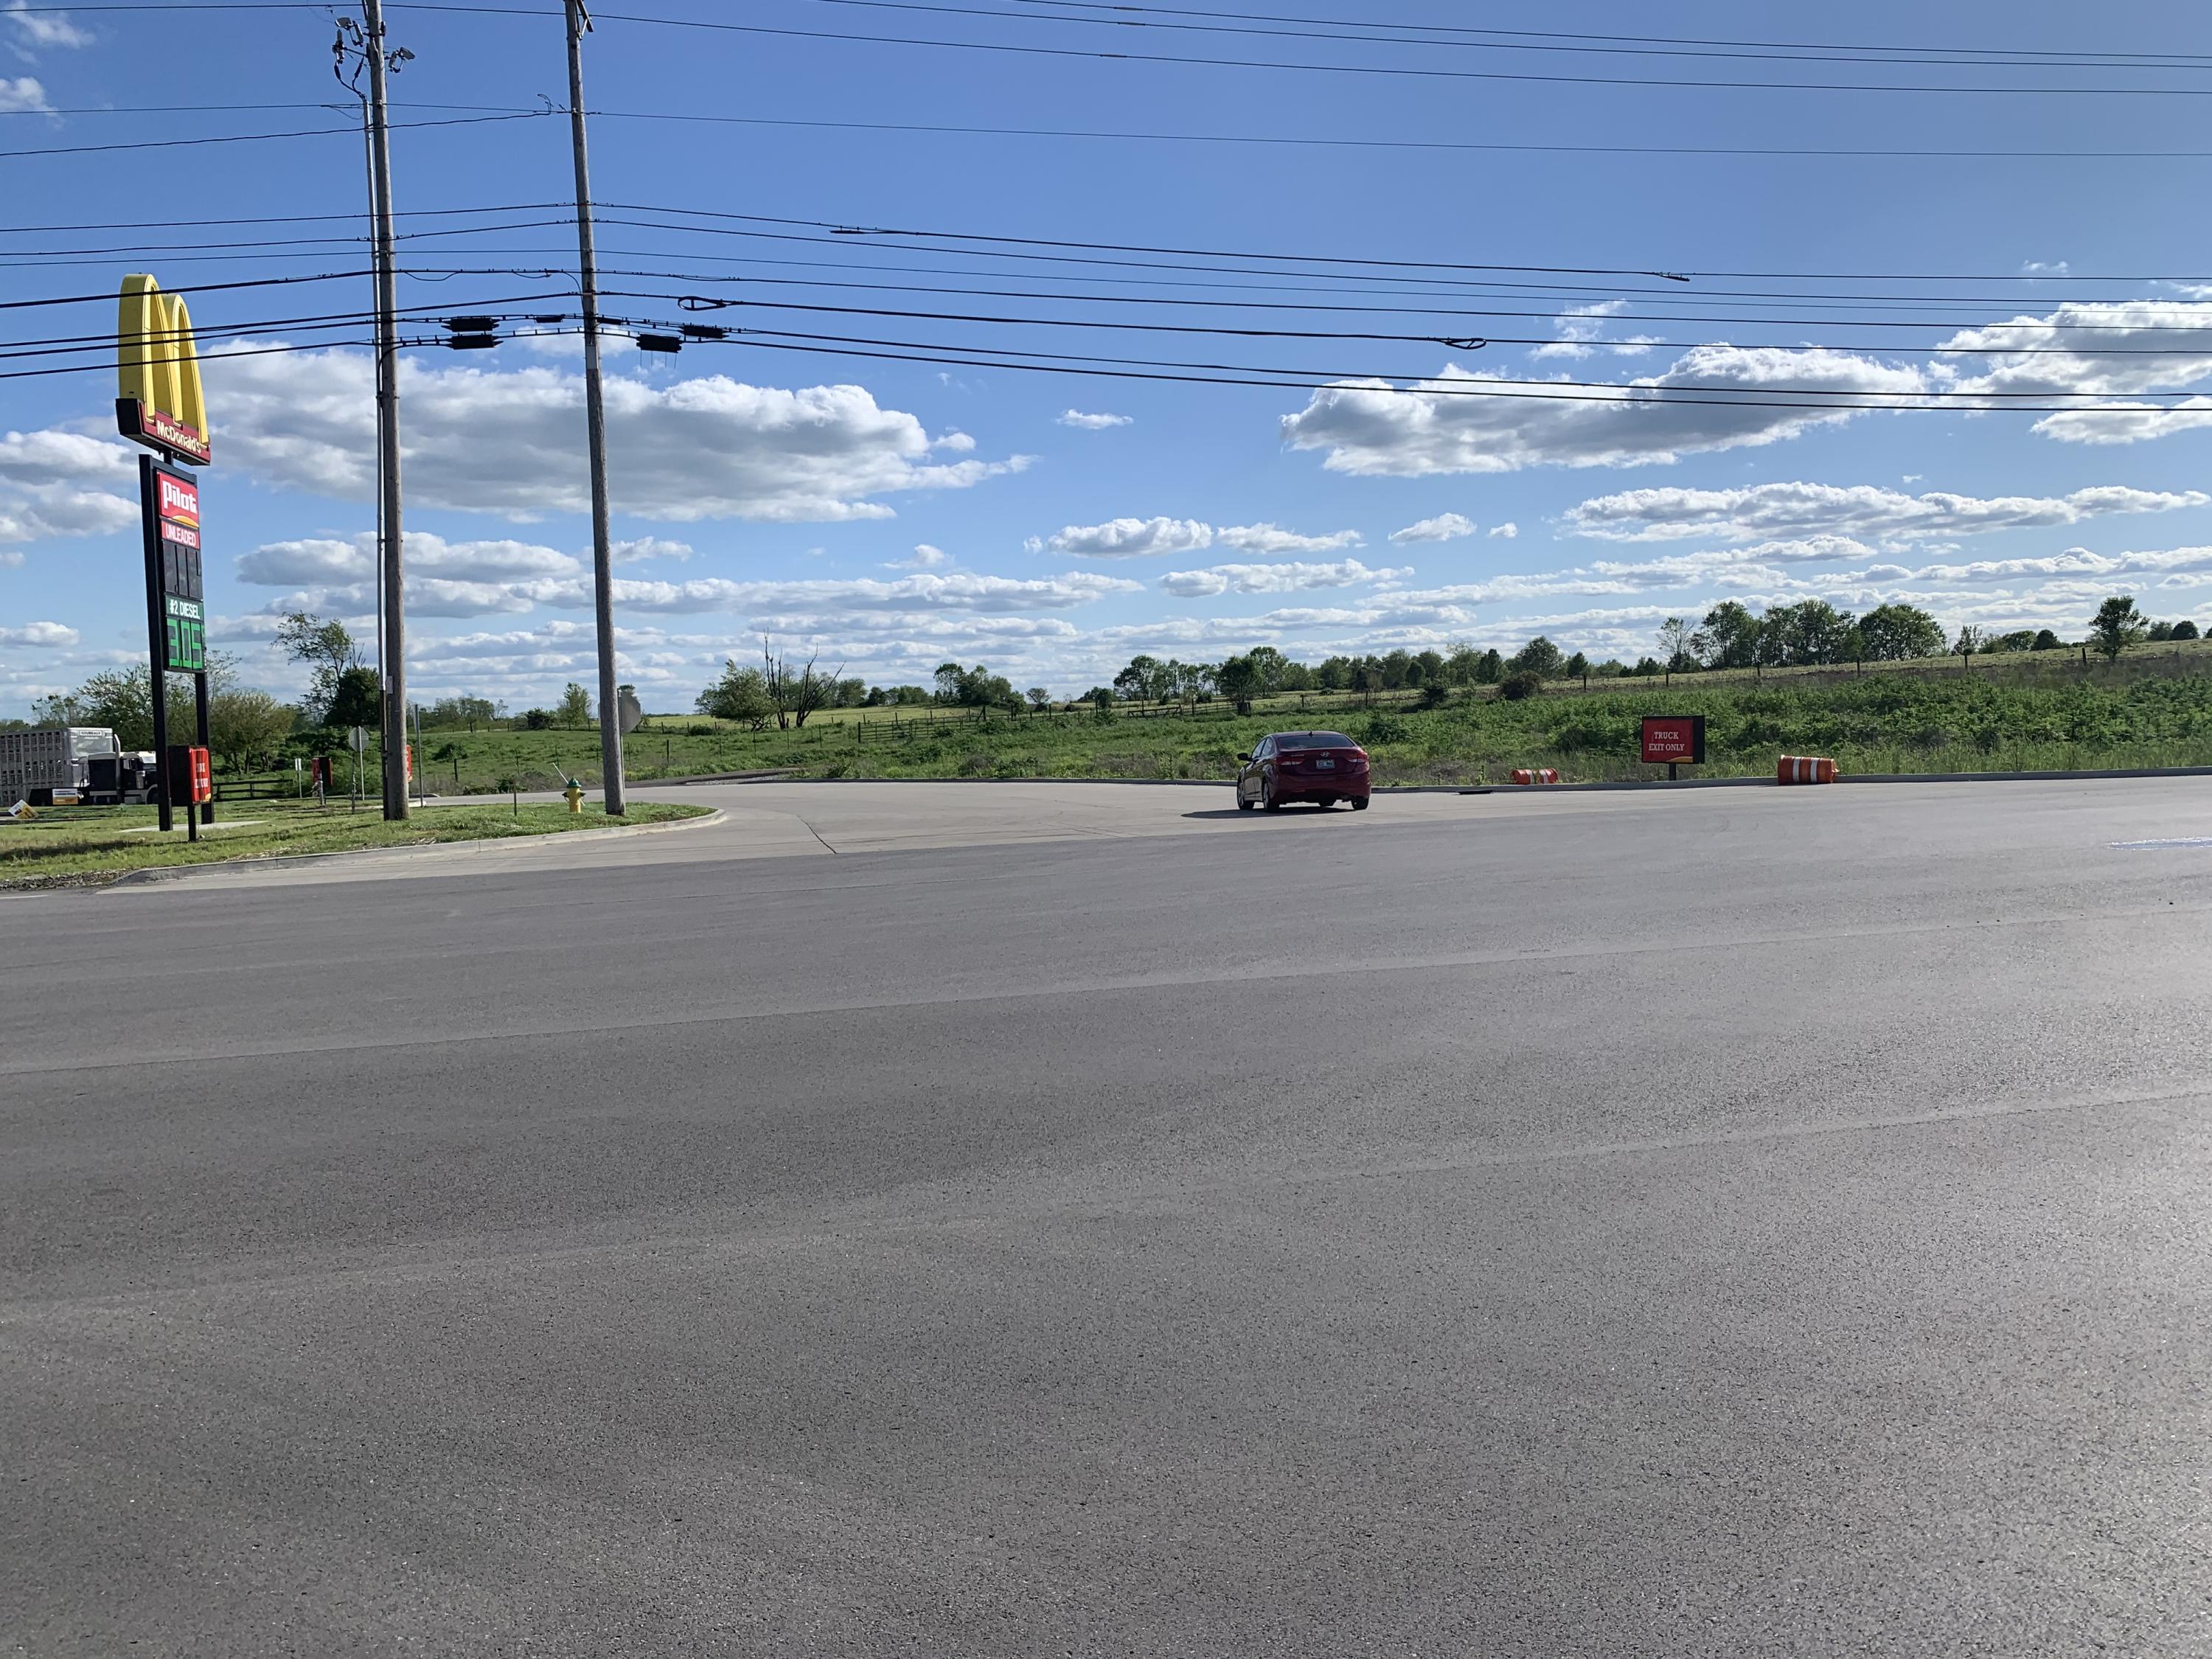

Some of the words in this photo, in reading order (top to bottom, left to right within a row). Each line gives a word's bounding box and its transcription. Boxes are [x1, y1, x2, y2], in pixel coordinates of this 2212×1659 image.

[157, 420, 201, 453] McDonald's
[165, 524, 196, 546] UNLEADED
[170, 599, 178, 615] #2
[179, 602, 201, 619] DIESEL
